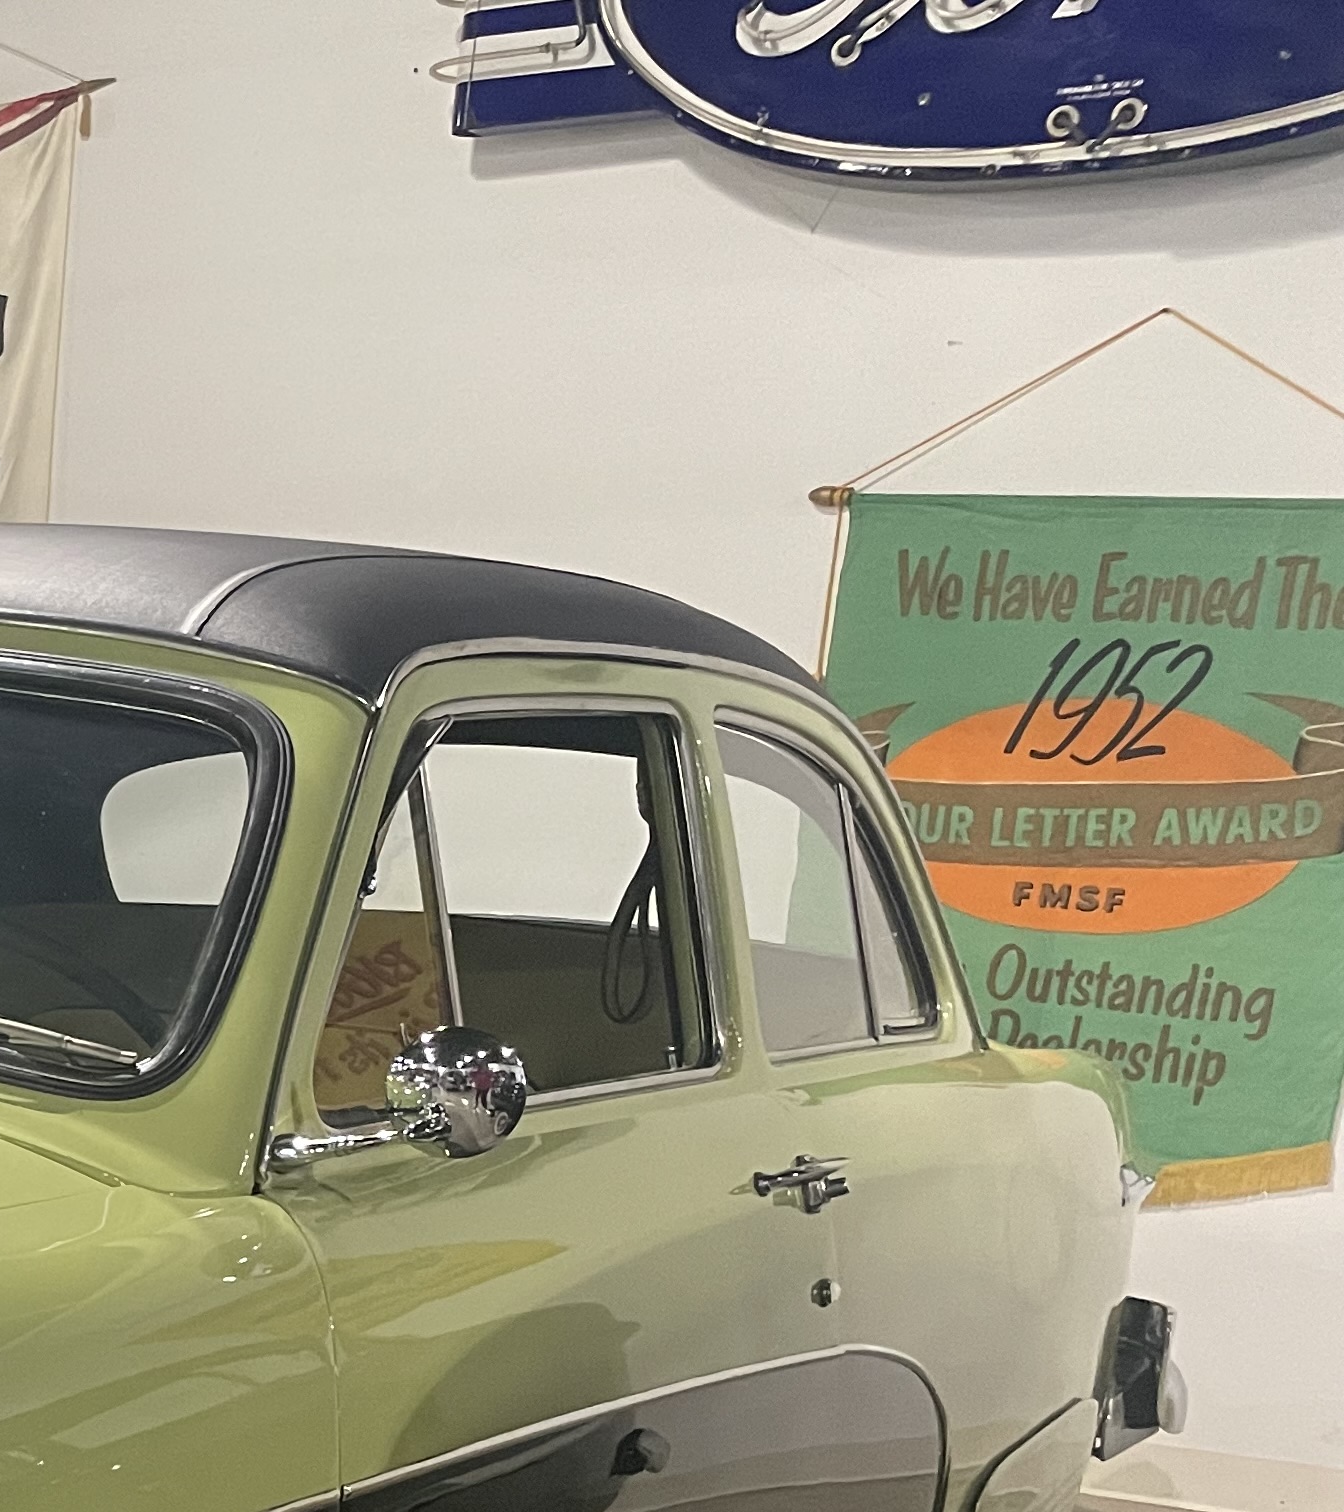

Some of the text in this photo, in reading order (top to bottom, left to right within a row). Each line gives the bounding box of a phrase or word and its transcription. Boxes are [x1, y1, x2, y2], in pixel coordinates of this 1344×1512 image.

[898, 546, 964, 620] We
[973, 549, 1079, 622] Have
[1092, 551, 1267, 630] Earned
[1003, 638, 1213, 766] 1952
[990, 806, 1136, 849] LETTER
[1154, 799, 1324, 846] AWARD
[1012, 881, 1126, 913] FMSF
[986, 944, 1275, 1041] Outstanding
